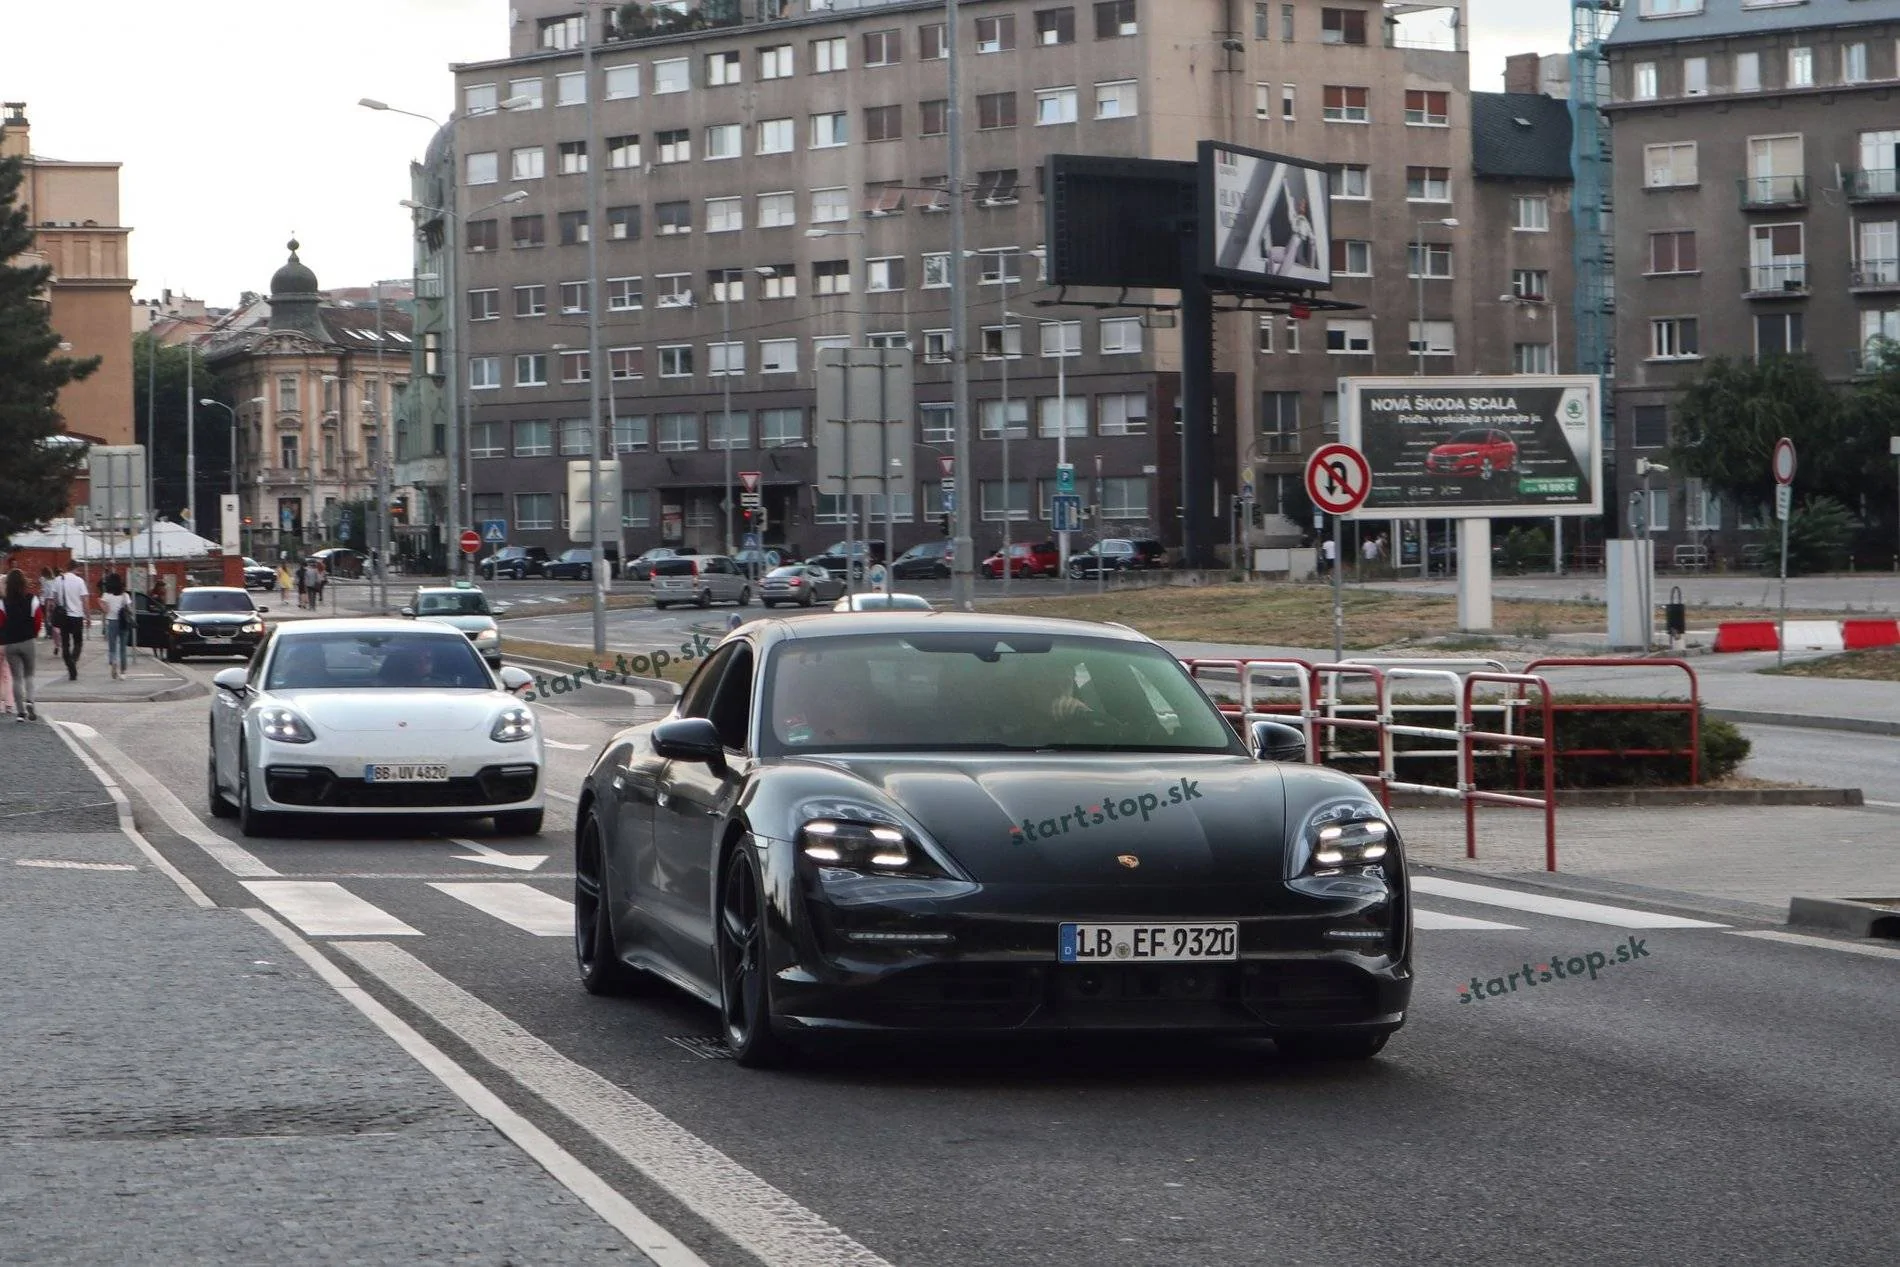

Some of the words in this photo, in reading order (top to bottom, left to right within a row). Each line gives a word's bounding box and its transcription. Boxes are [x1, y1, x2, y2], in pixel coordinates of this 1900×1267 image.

[1370, 395, 1412, 411] NOVÁ
[1414, 395, 1466, 411] ŠKODA
[1468, 397, 1518, 411] SCALA
[399, 766, 416, 779] UV
[1133, 928, 1166, 957] EF
[1174, 927, 1235, 957] 9320
